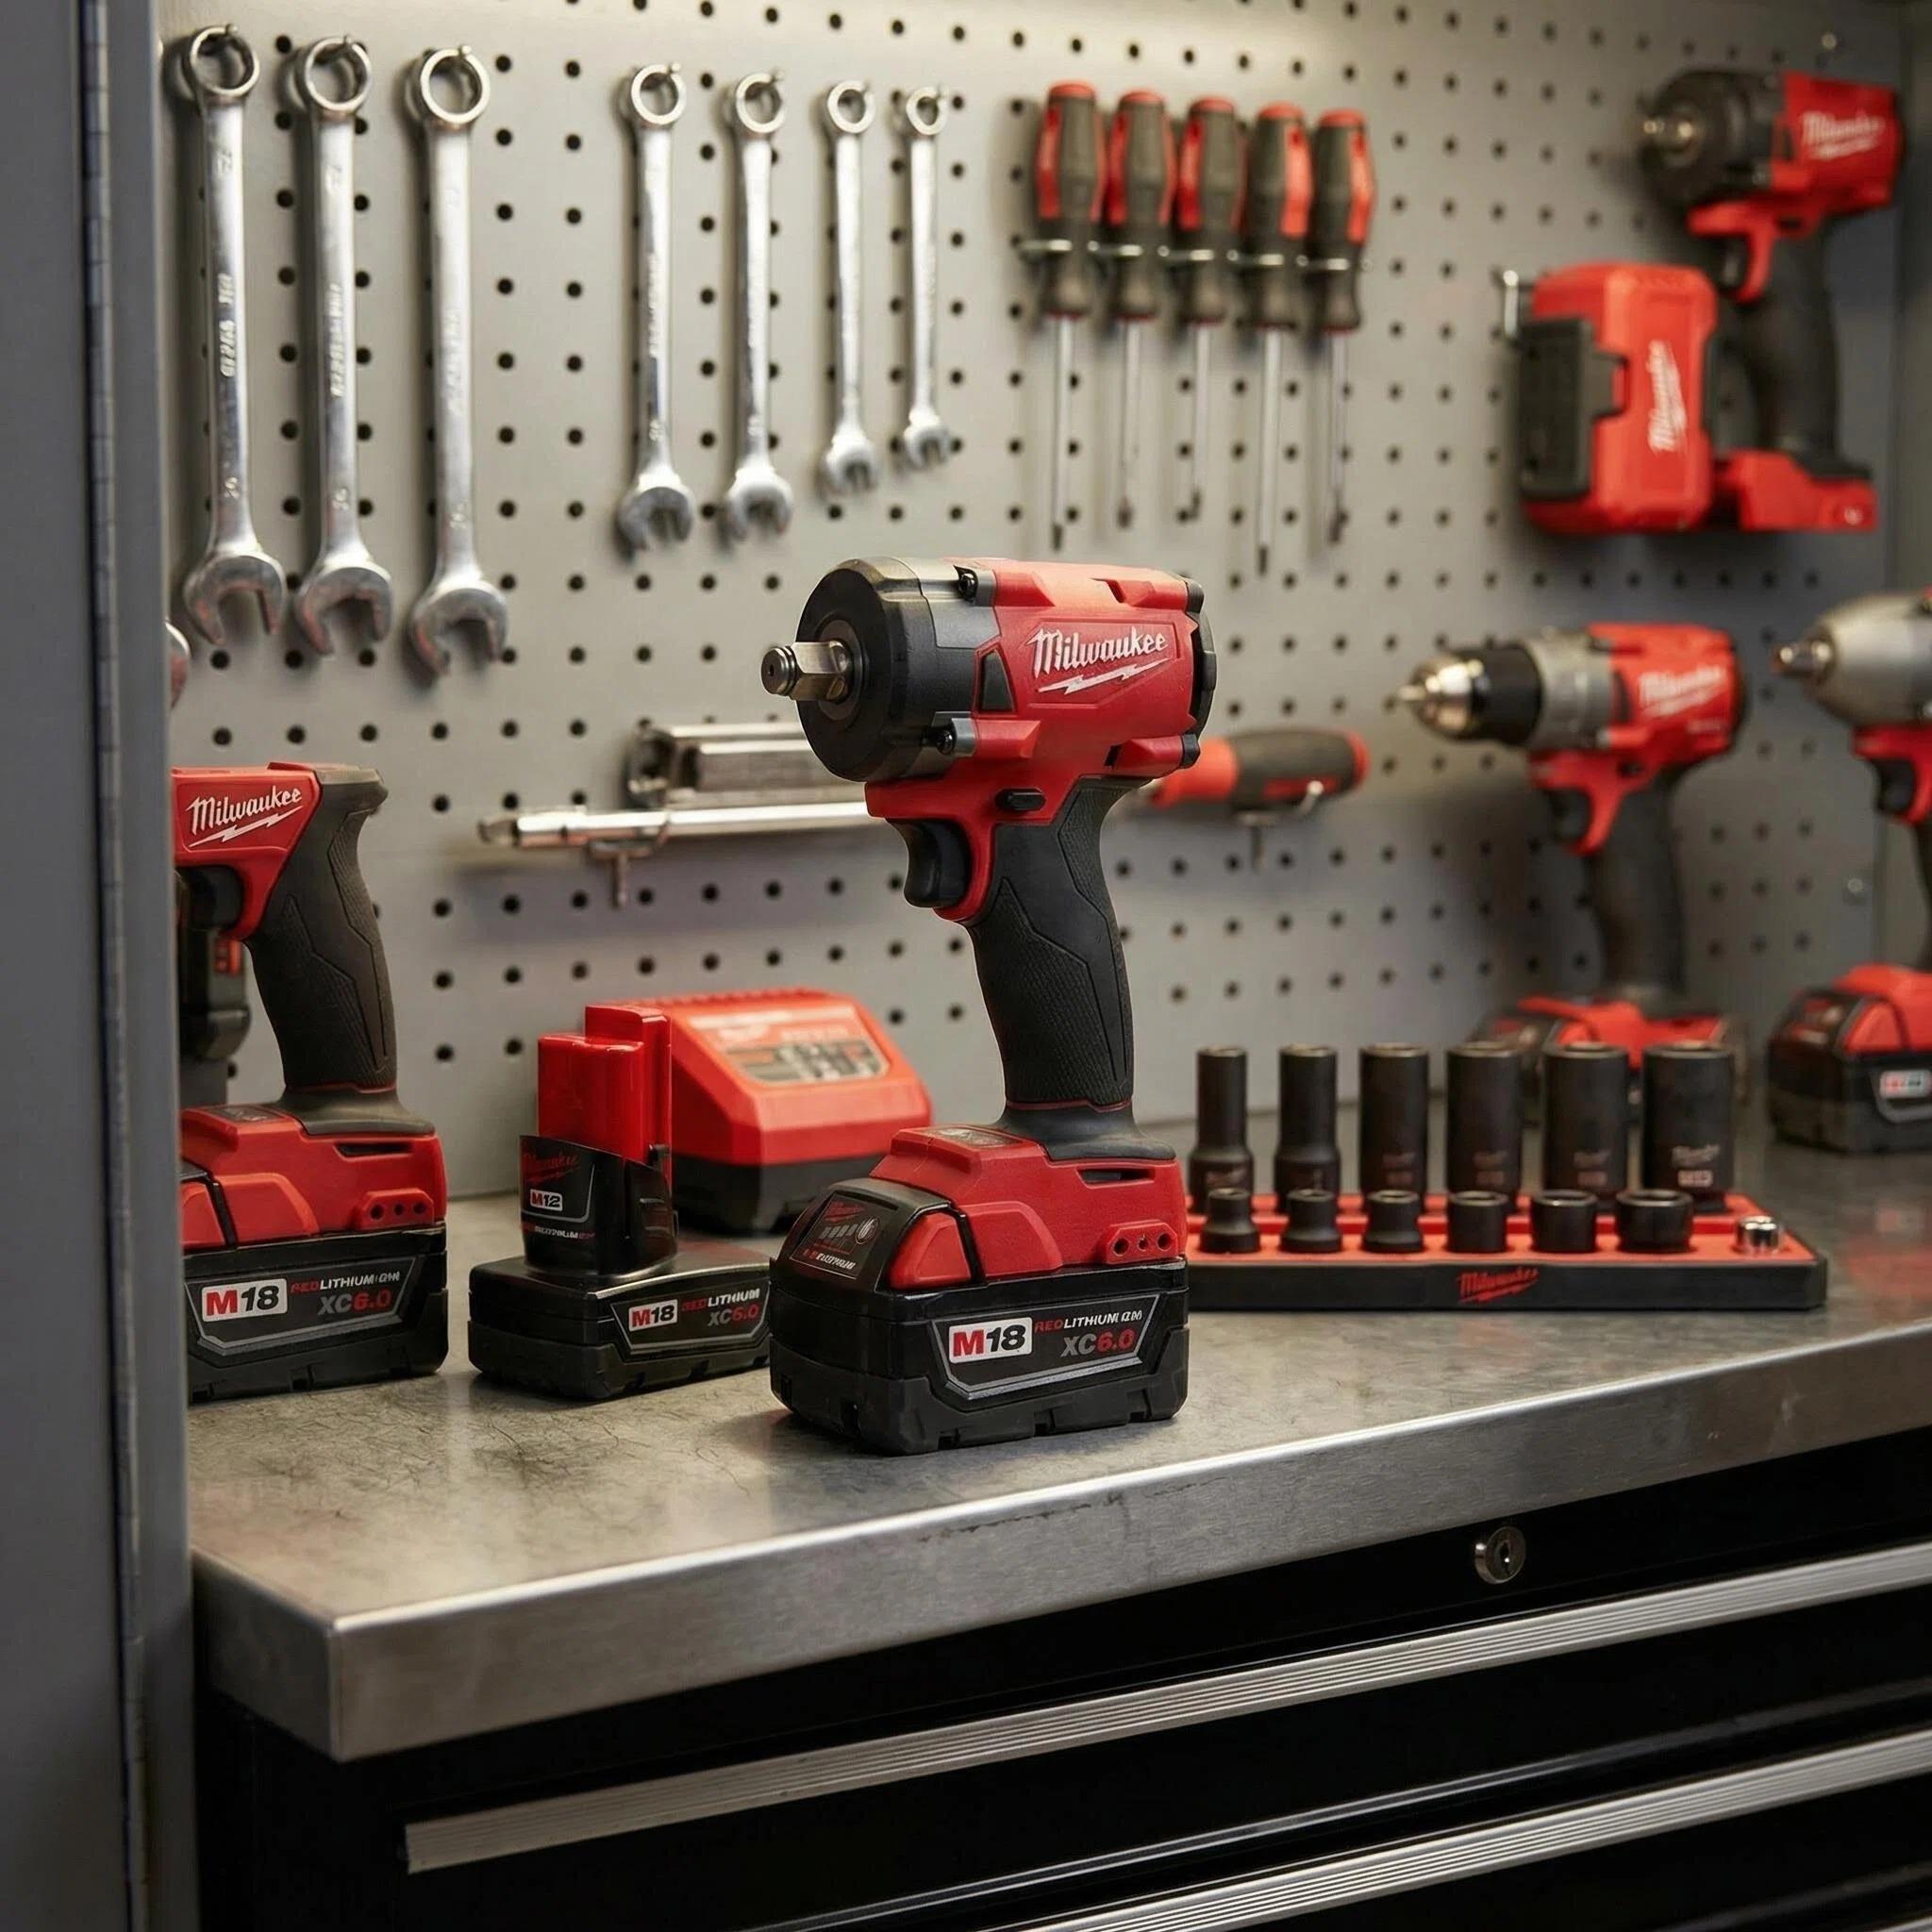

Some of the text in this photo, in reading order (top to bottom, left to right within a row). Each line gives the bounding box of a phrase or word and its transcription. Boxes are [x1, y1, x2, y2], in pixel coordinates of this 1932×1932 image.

[1025, 625, 1170, 679] Milwaukee
[185, 785, 302, 836] Milwaukee
[531, 1191, 561, 1208] M12
[206, 1285, 280, 1317] M18
[317, 1289, 392, 1316] XC6.0
[708, 1304, 759, 1326] XC6.0
[631, 1305, 675, 1328] M18
[953, 1324, 1026, 1357] M18
[1060, 1328, 1136, 1357] XC6.0
